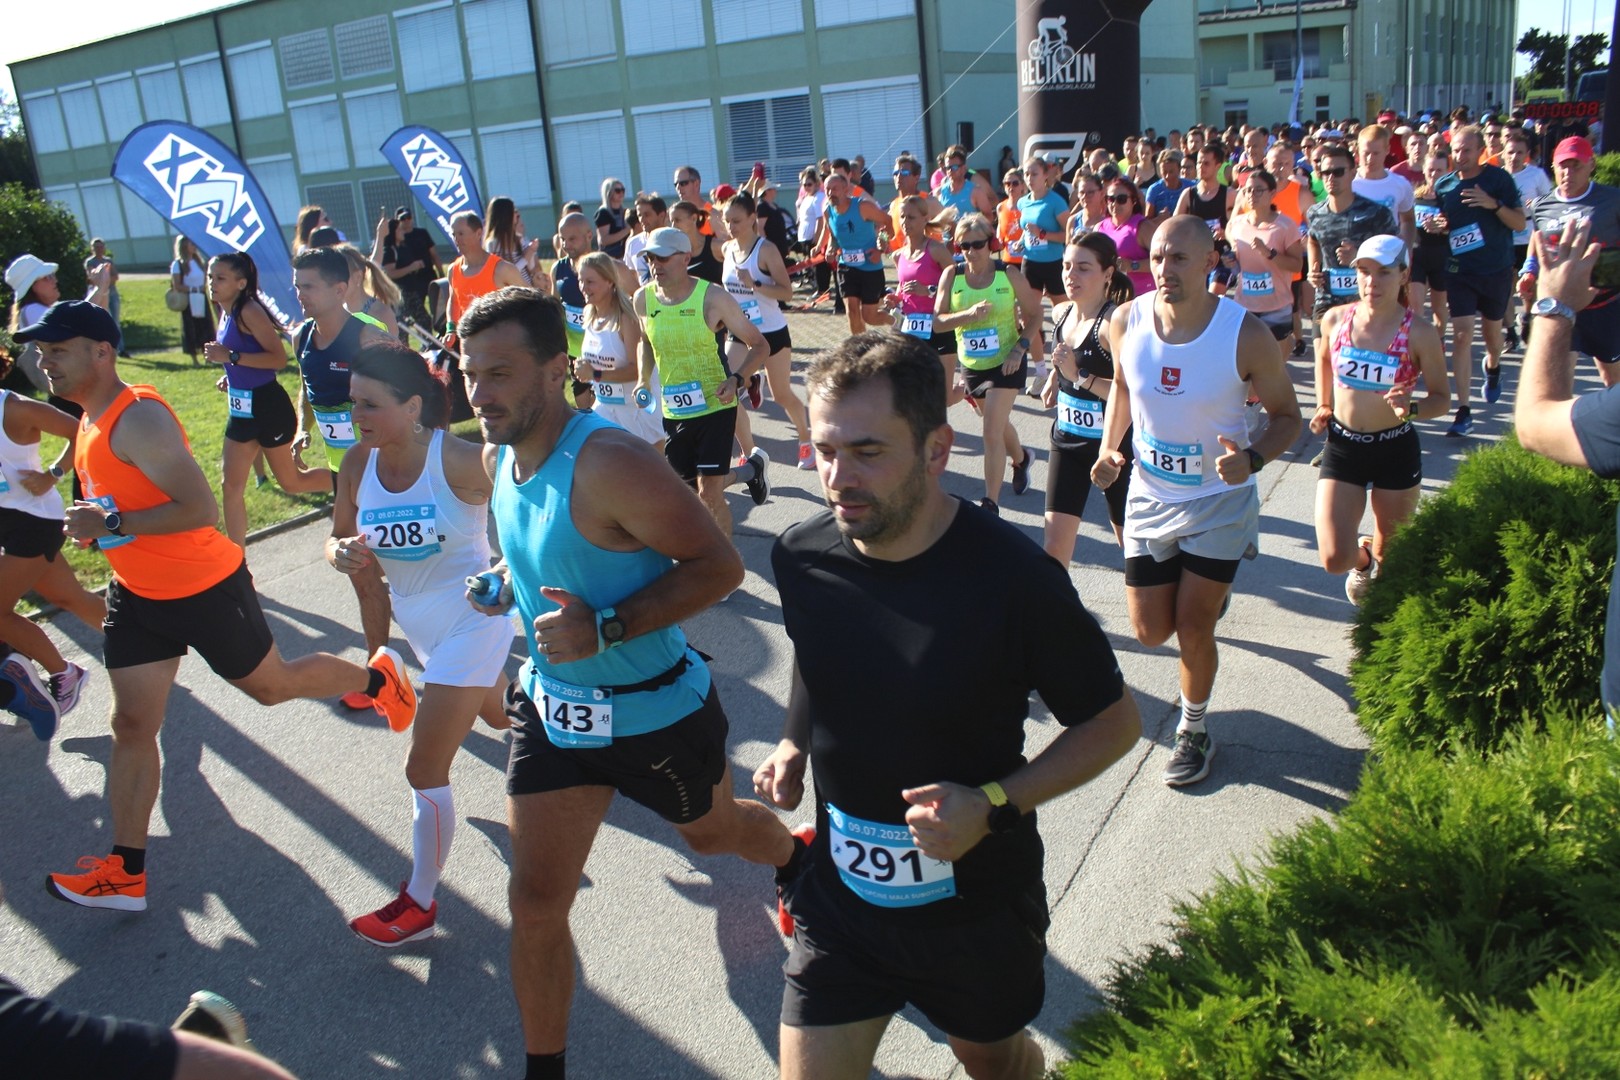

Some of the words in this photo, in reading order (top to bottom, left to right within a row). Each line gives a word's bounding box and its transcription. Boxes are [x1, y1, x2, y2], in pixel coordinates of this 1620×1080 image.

[1453, 232, 1477, 248] 292
[1246, 280, 1267, 290] 144
[969, 338, 988, 350] 94
[1345, 360, 1383, 383] 211
[599, 384, 613, 397] 89
[673, 393, 693, 408] 90
[1065, 407, 1094, 428] 180
[326, 424, 337, 439] 2
[1342, 429, 1375, 443] PRO
[1379, 421, 1411, 442] NIKE
[1150, 450, 1187, 474] 181
[378, 509, 416, 519] 09.07.2022.
[374, 521, 424, 548] 208
[543, 694, 594, 733] 143
[848, 821, 915, 841] 09.07.2022.
[845, 840, 923, 883] 291
